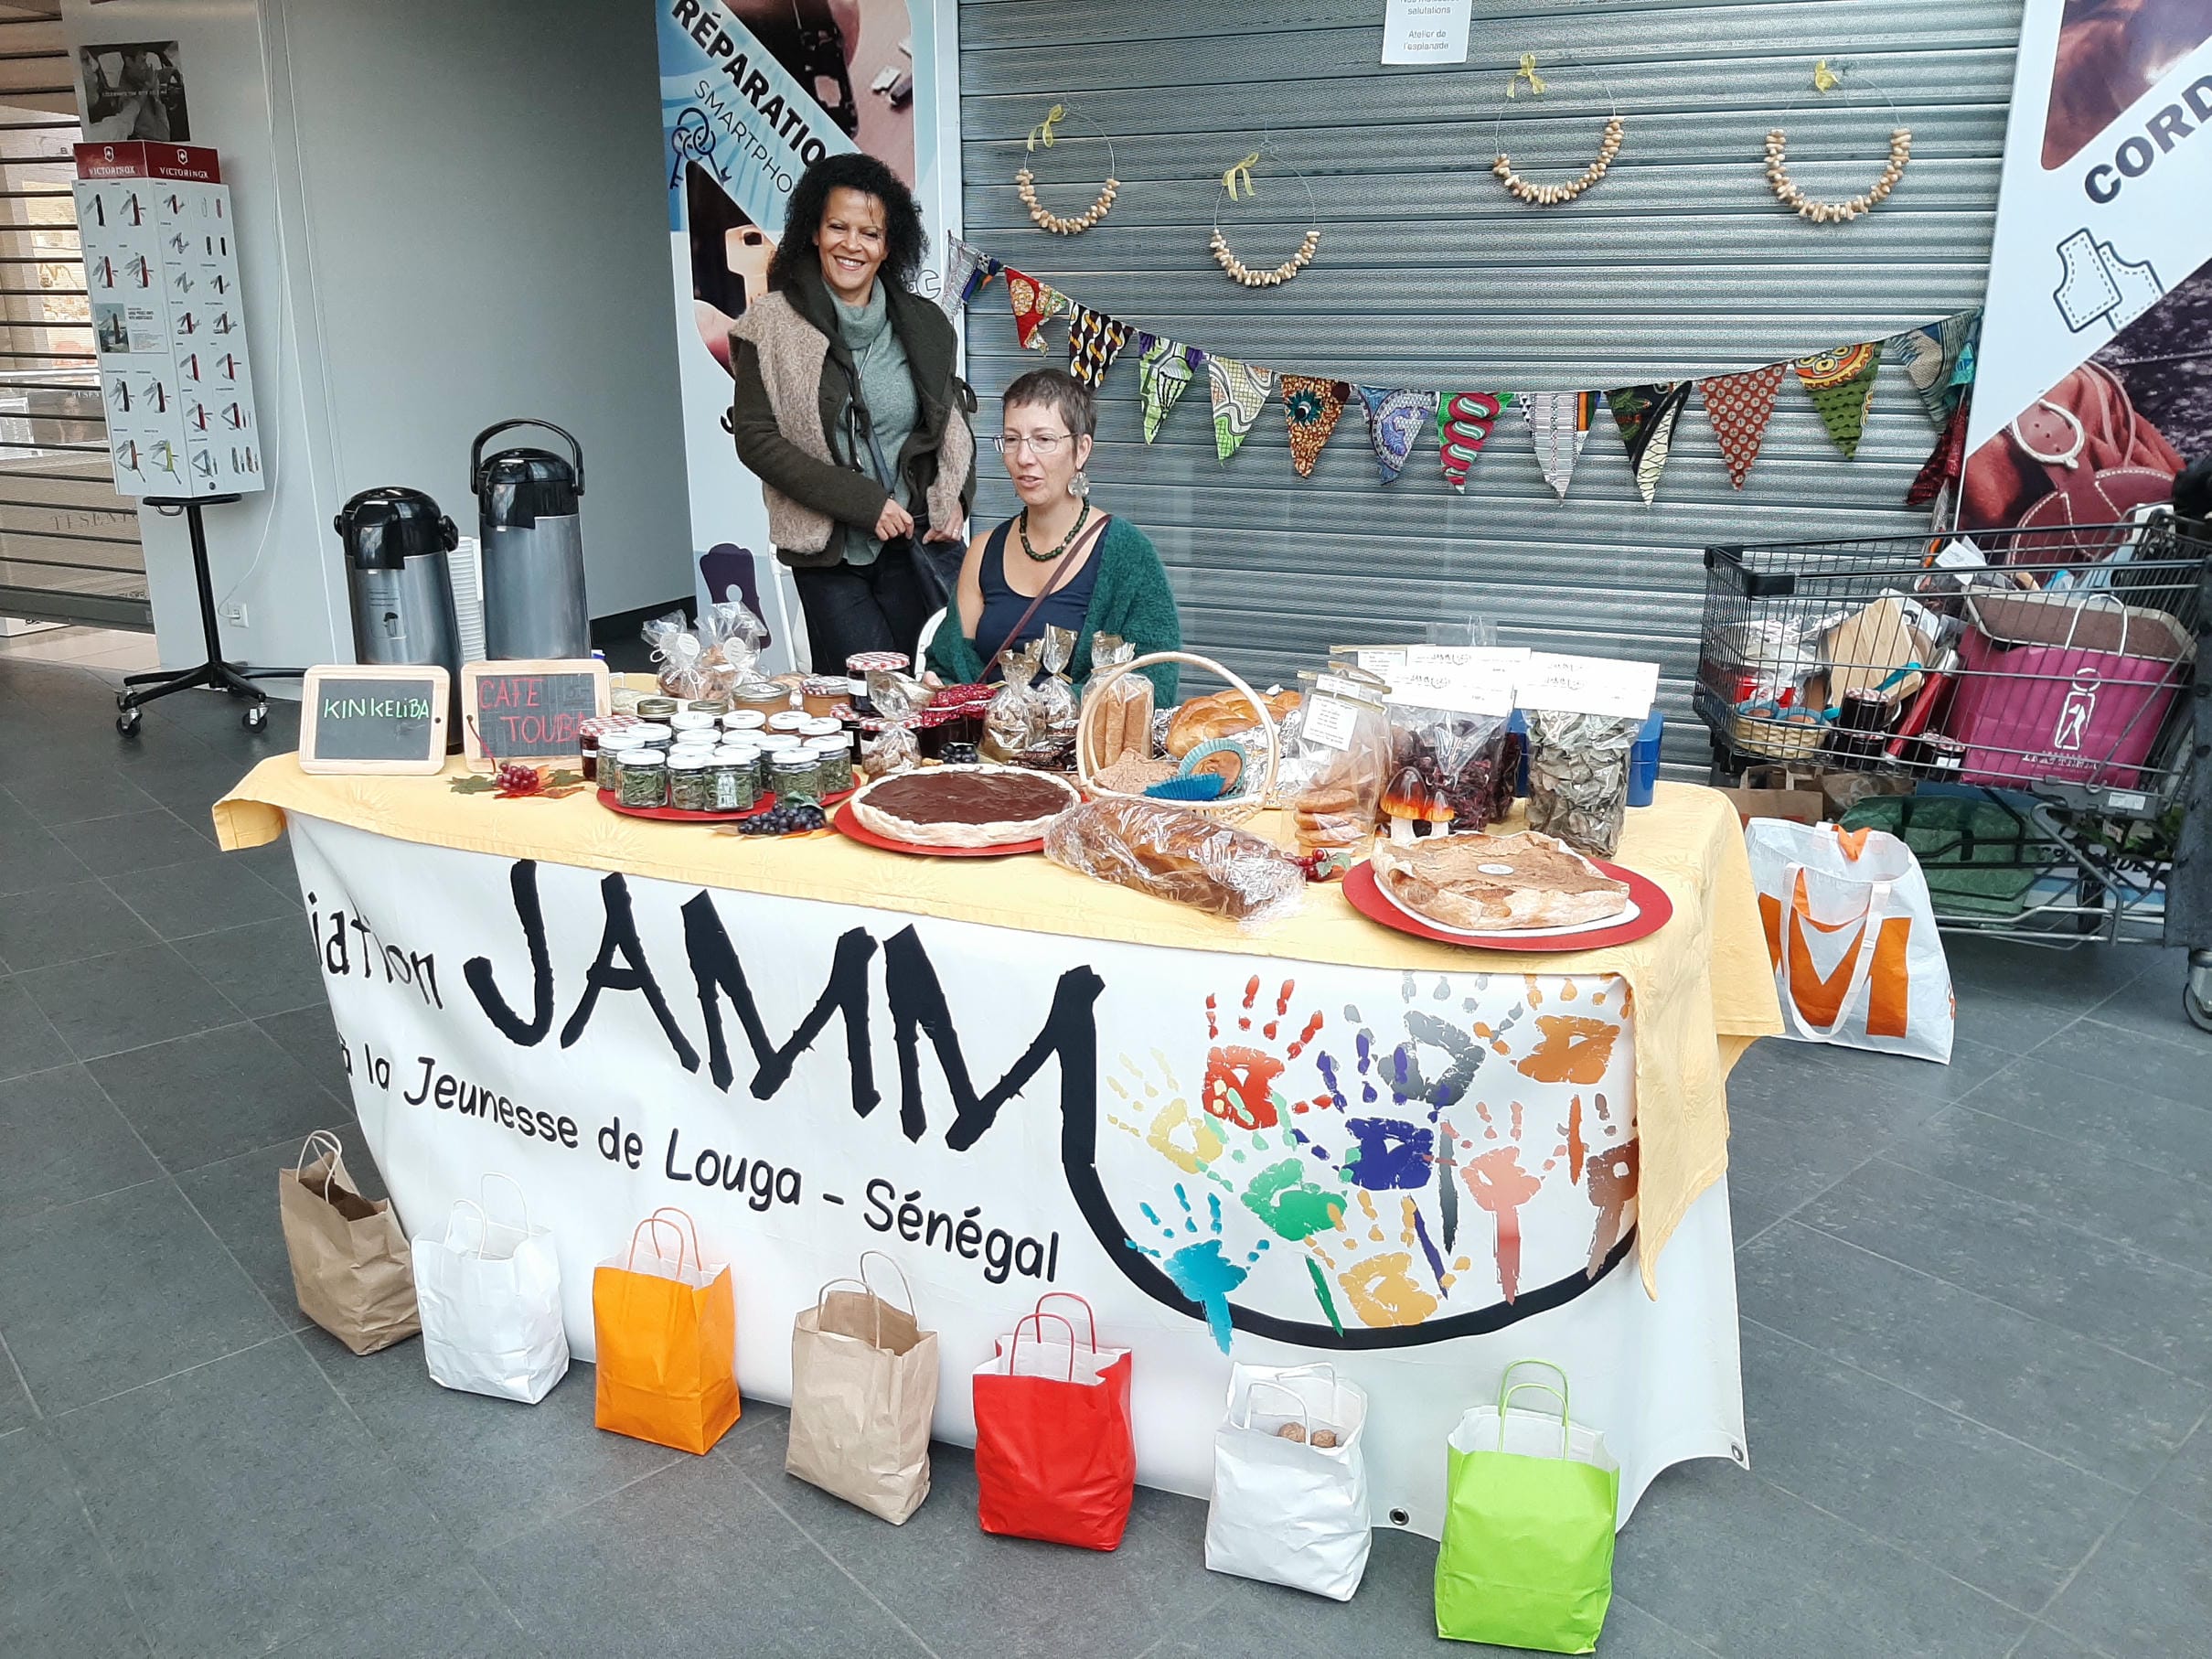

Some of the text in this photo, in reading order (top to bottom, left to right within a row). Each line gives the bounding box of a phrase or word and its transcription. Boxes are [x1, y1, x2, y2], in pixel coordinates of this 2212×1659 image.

[1407, 6, 1451, 16] salutations
[1408, 29, 1447, 38] Atelier de
[2084, 75, 2212, 204] CORD
[88, 165, 136, 177] VICTORINOX
[478, 678, 546, 710] CAFE
[464, 858, 1106, 1153] JAMM
[364, 1042, 390, 1092] la
[403, 1056, 579, 1149] Jeunesse
[597, 1116, 644, 1170] de
[665, 1128, 802, 1213] Louga
[863, 1177, 1060, 1284] Sénégal
